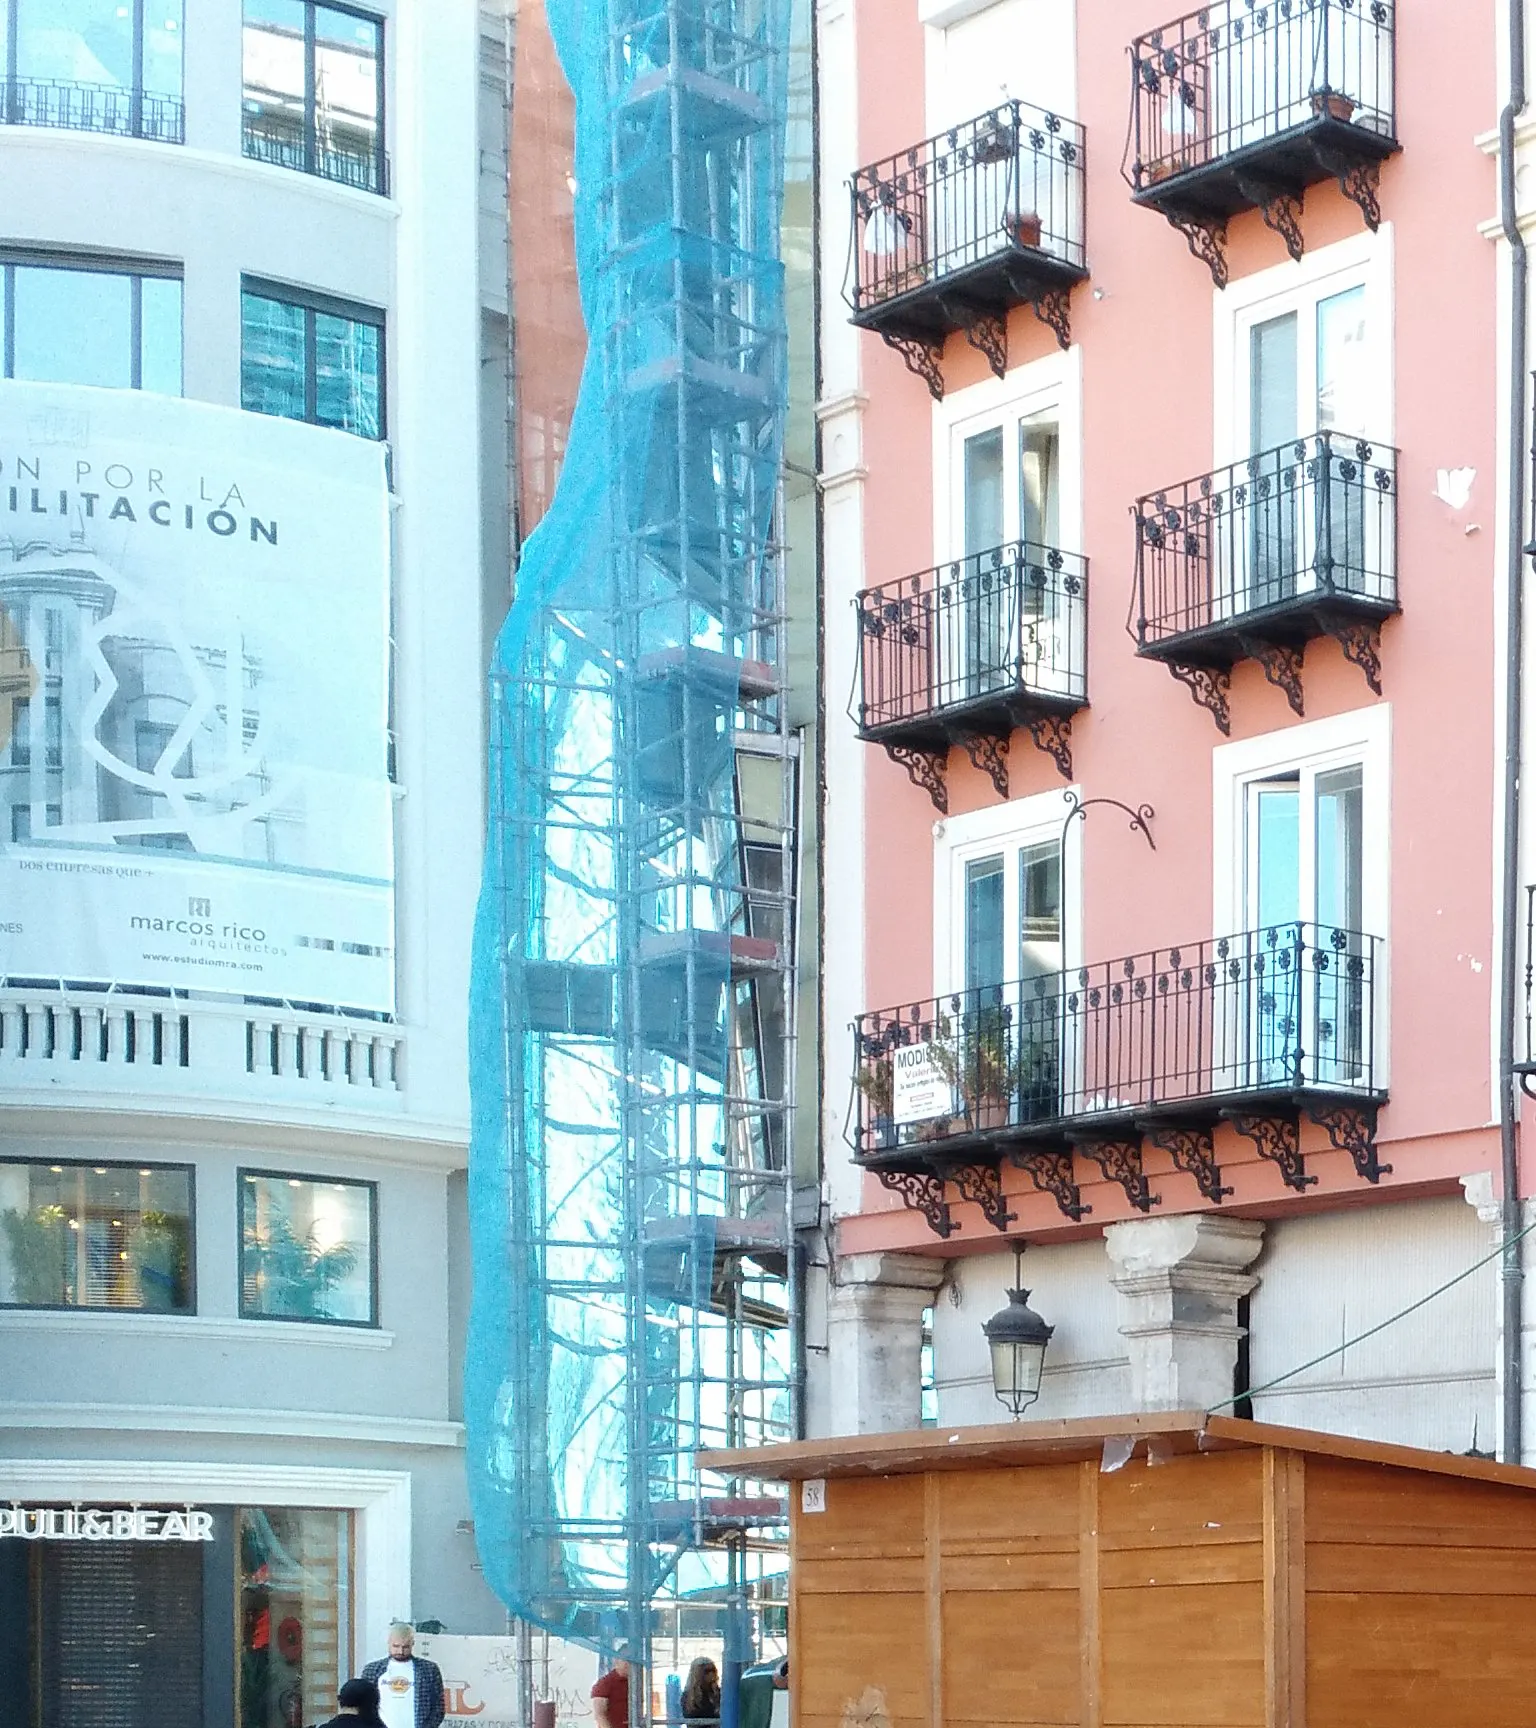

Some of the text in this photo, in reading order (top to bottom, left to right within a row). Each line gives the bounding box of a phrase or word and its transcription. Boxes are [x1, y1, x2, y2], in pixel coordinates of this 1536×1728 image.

[0, 456, 246, 508] N POR LA
[8, 485, 278, 546] ILITACIÓN
[130, 916, 267, 942] marcos rico
[190, 938, 288, 957] arquitectos
[806, 1486, 819, 1507] 58
[0, 1508, 214, 1541] PULL&BEAR
